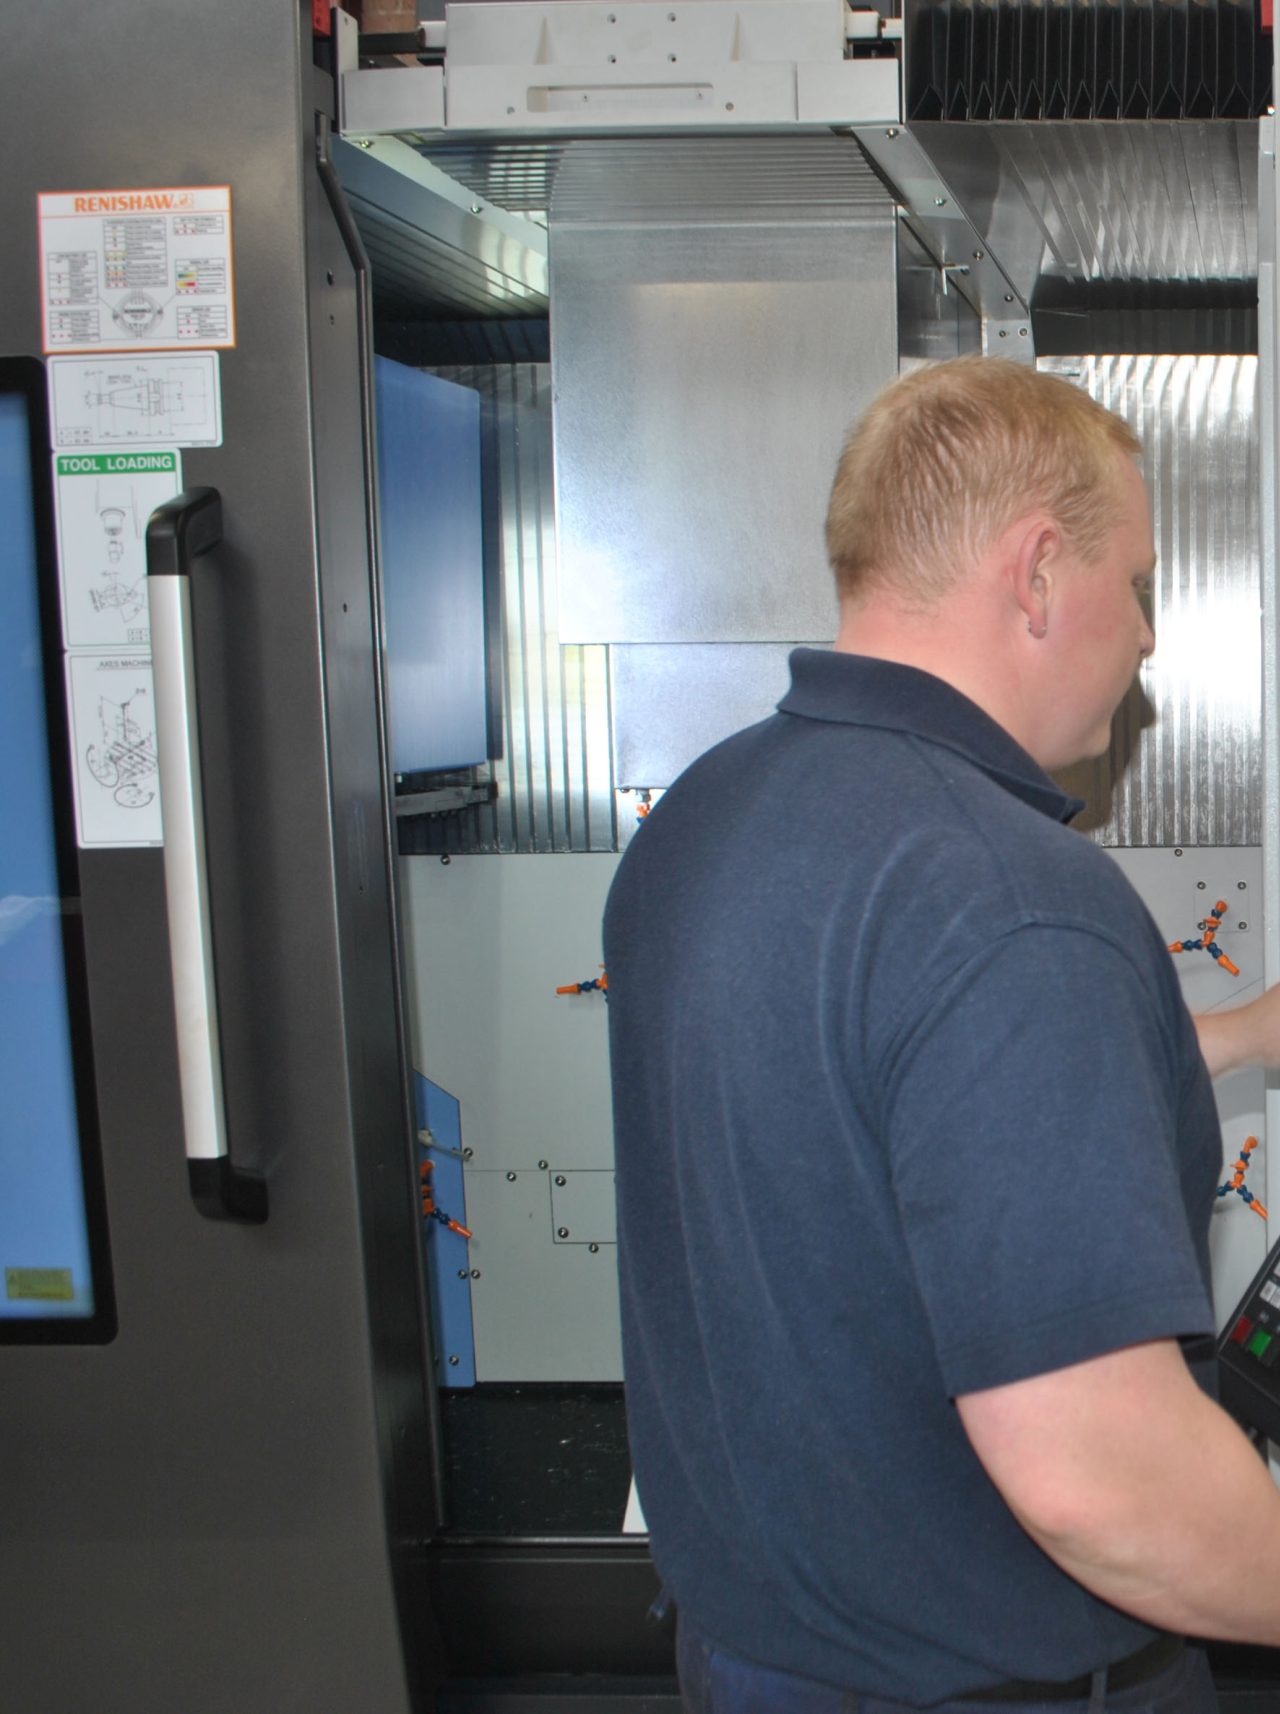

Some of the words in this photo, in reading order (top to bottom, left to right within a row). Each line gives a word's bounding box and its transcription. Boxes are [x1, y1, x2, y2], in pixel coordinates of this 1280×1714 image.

[74, 194, 173, 212] RENISHAW
[60, 458, 101, 472] TOOL
[107, 455, 173, 470] LOADING
